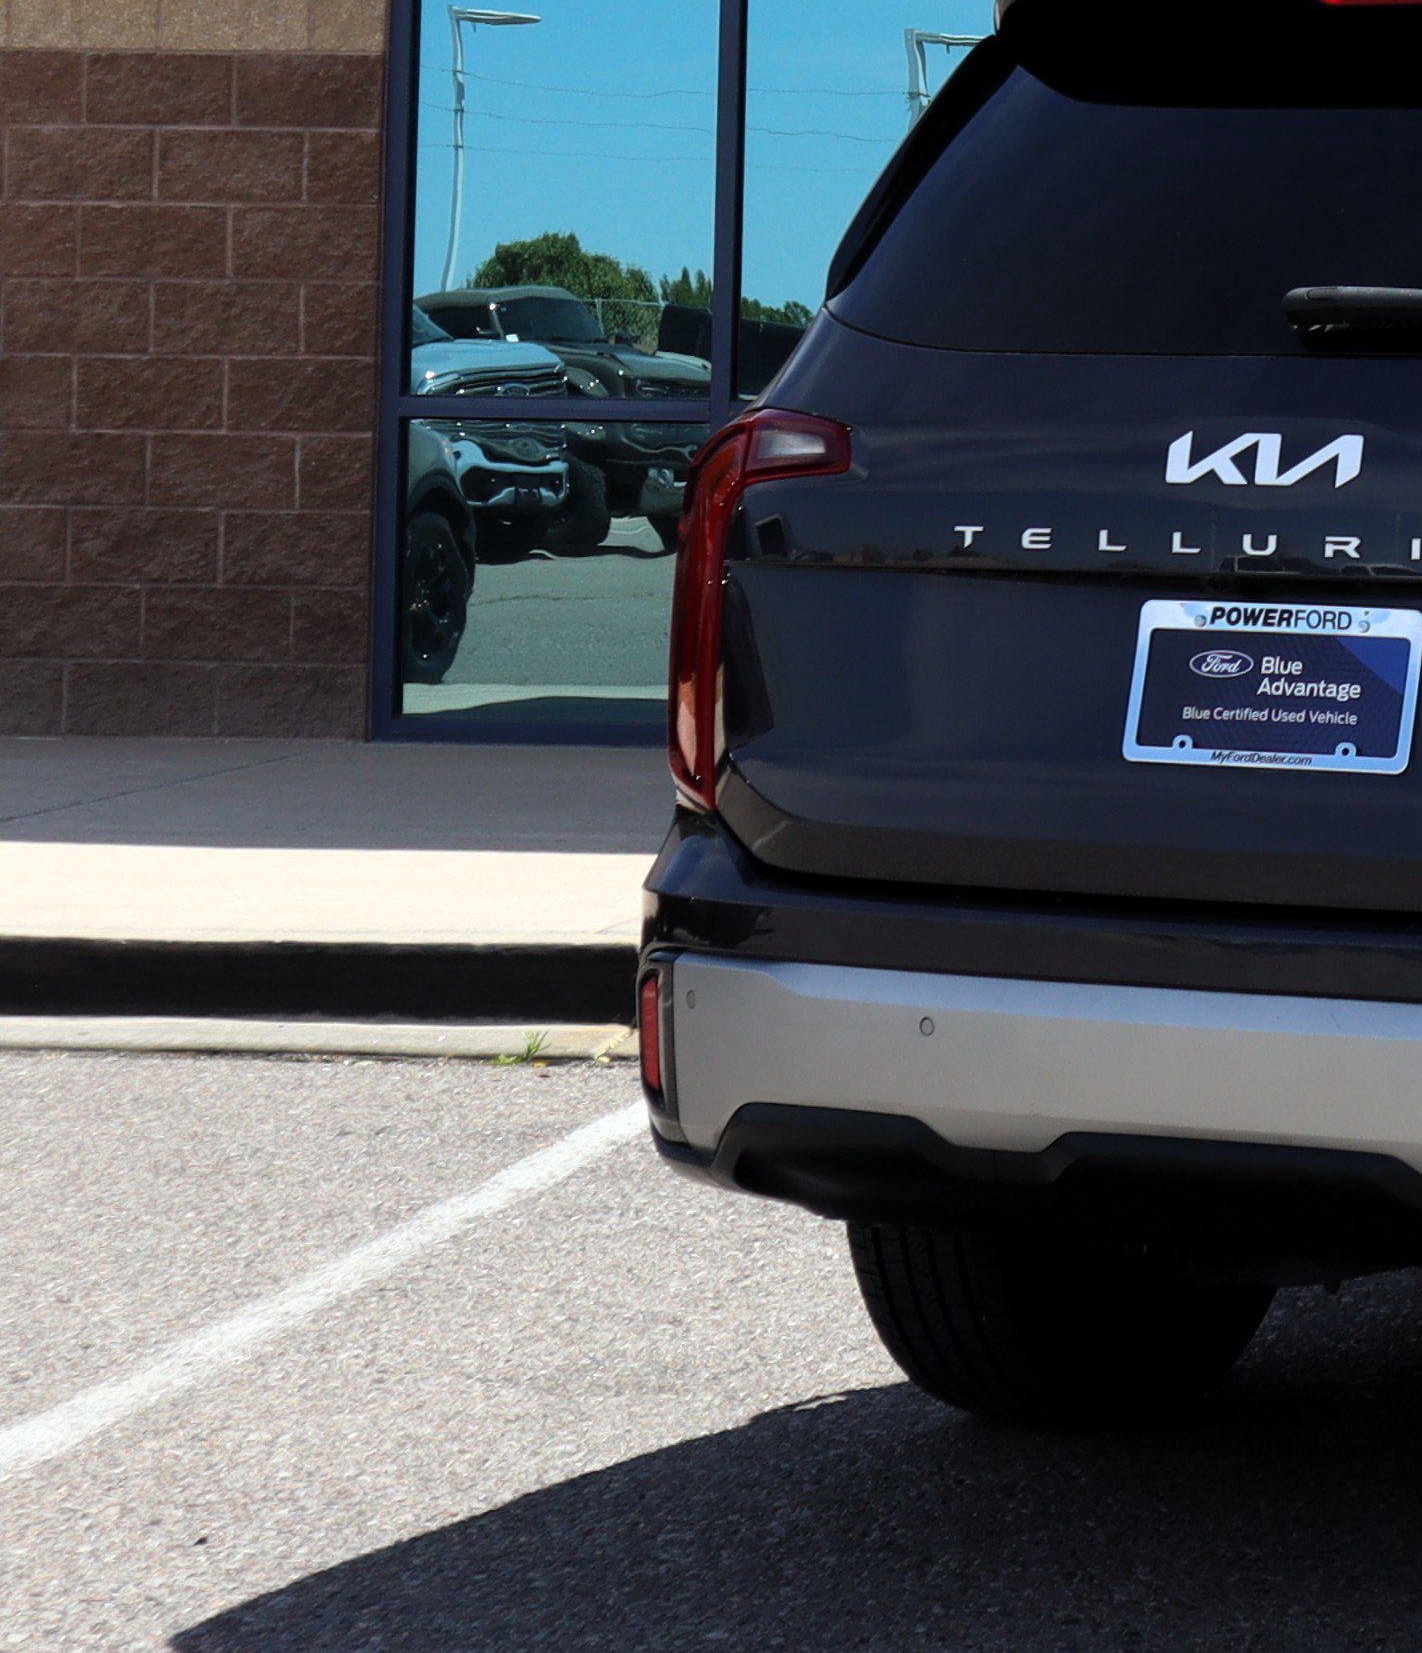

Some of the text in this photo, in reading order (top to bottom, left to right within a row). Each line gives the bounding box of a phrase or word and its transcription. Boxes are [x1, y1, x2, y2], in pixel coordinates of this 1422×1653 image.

[1164, 431, 1365, 488] KIA
[1210, 606, 1352, 630] POWERFORD
[1201, 653, 1303, 675] Ford Blue
[1257, 678, 1361, 701] Advantage
[1182, 706, 1358, 725] Blue Certified Used Vehicle
[1210, 750, 1312, 766] MyFordDealer.com
